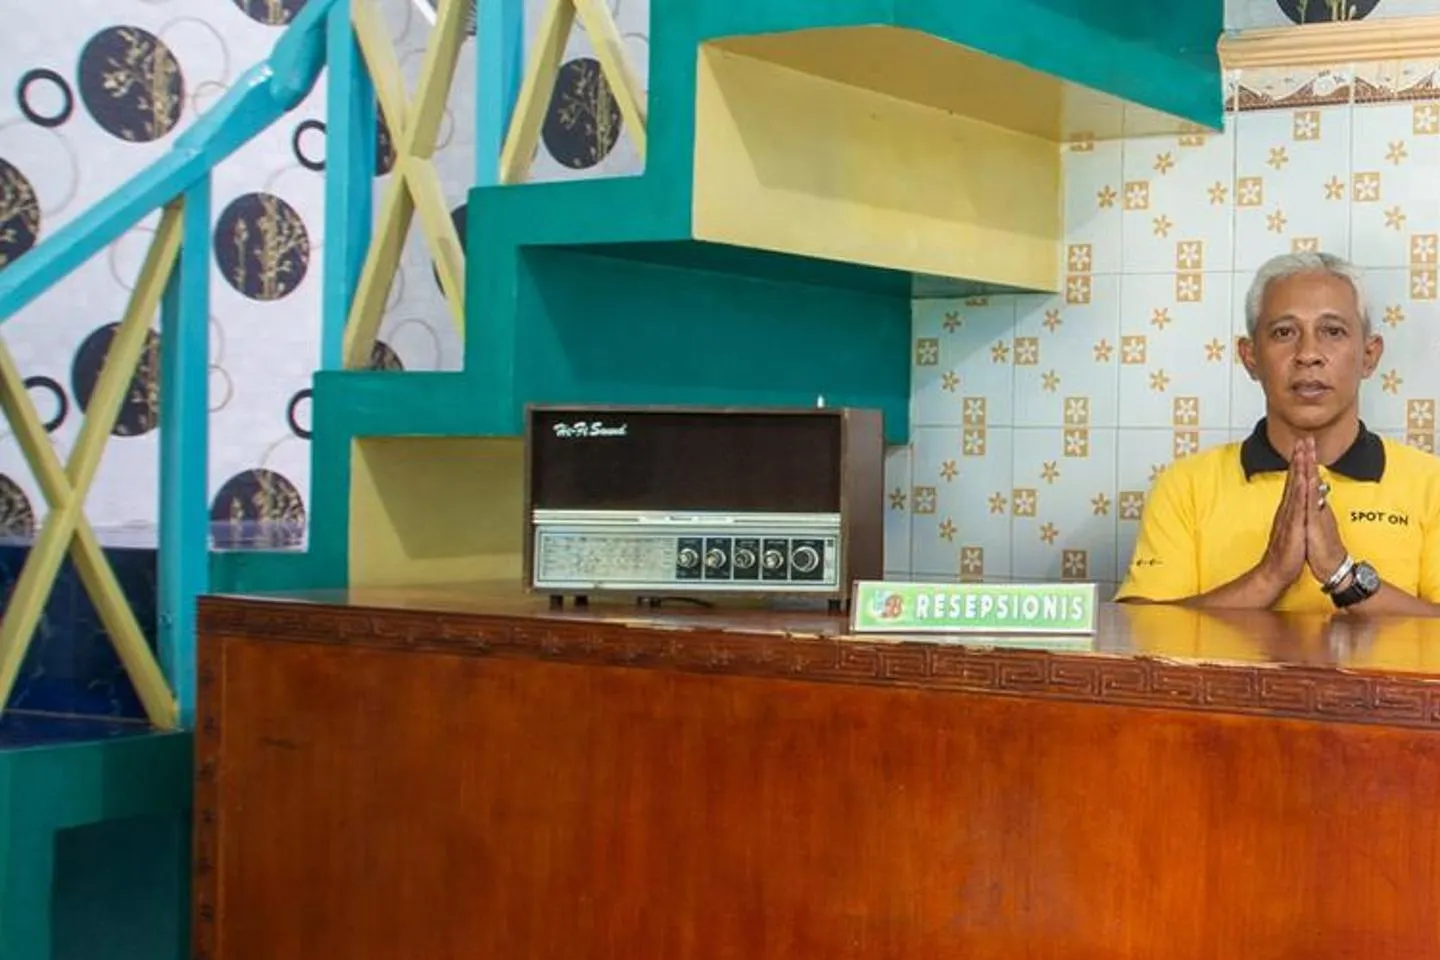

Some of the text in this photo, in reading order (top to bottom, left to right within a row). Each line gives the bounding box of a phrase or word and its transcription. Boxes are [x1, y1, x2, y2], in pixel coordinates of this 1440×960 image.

[1350, 511, 1408, 525] SPOT ON
[916, 593, 1083, 621] RESEPSIONIS
